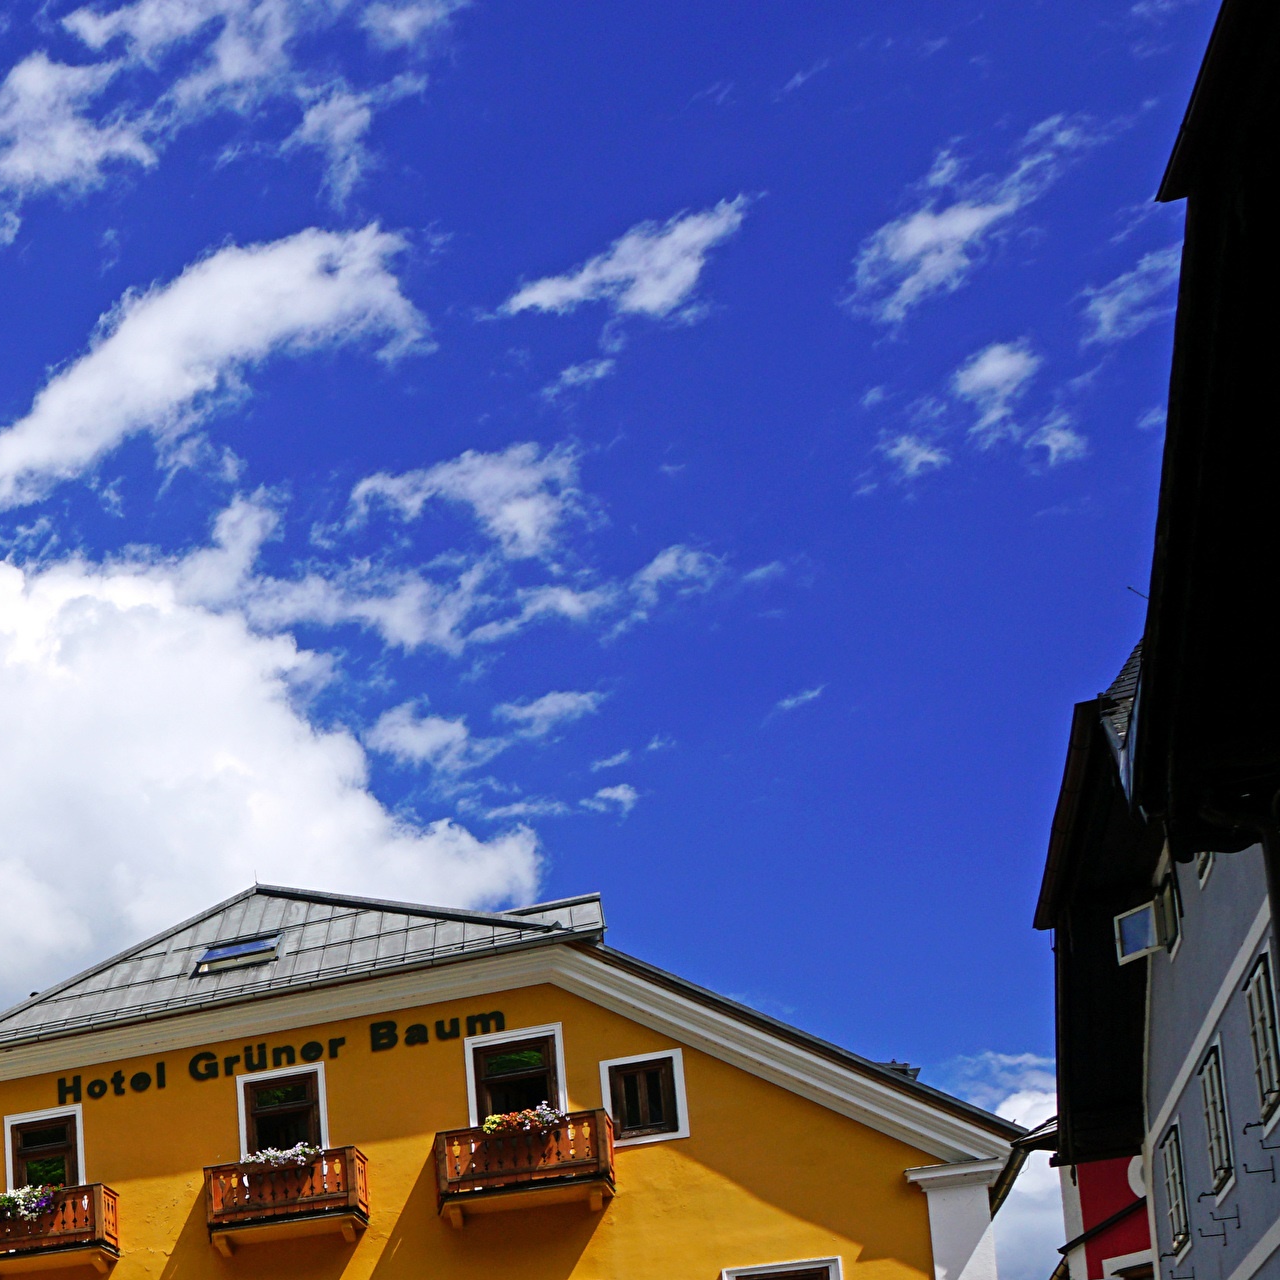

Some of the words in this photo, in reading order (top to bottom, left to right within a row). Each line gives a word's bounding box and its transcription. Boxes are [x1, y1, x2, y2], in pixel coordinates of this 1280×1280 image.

[57, 1061, 166, 1105] Hotel
[188, 1035, 346, 1081] Grüner
[369, 1010, 506, 1052] Baum
